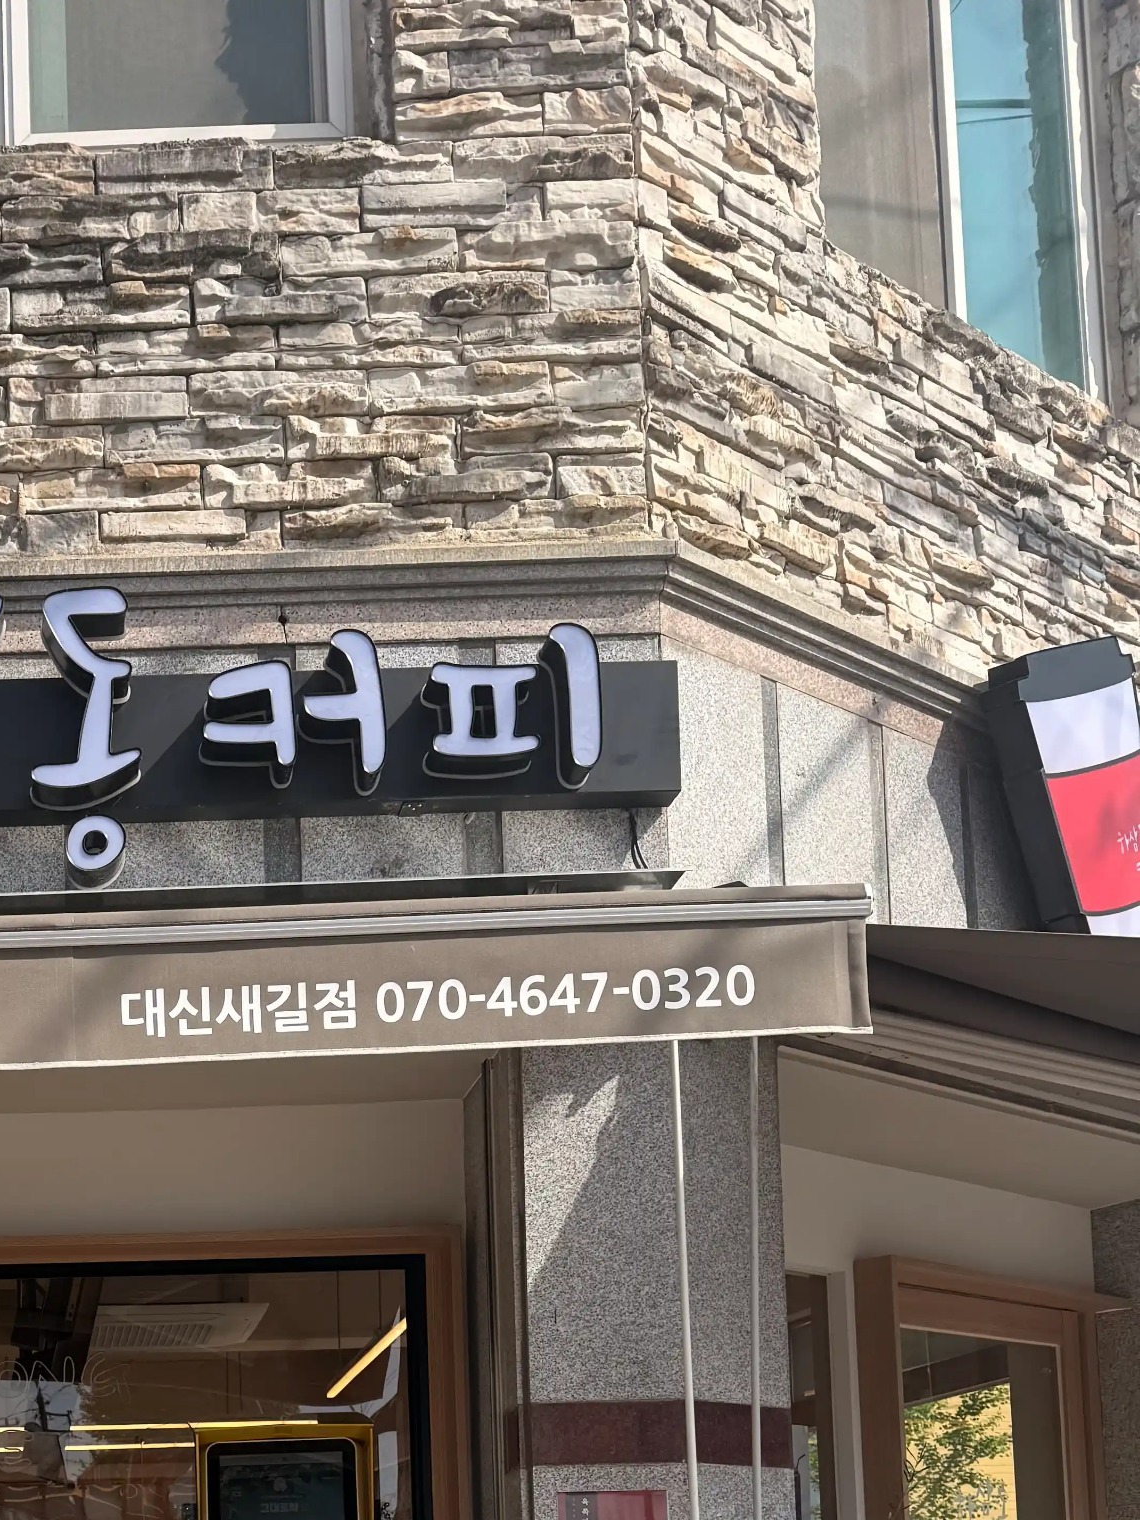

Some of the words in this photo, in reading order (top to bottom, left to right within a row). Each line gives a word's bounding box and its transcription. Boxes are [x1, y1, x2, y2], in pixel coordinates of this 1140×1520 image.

[1117, 824, 1140, 855] 하삼
[119, 980, 358, 1038] 대신새길점
[375, 964, 756, 1023] 070-4647-0320
